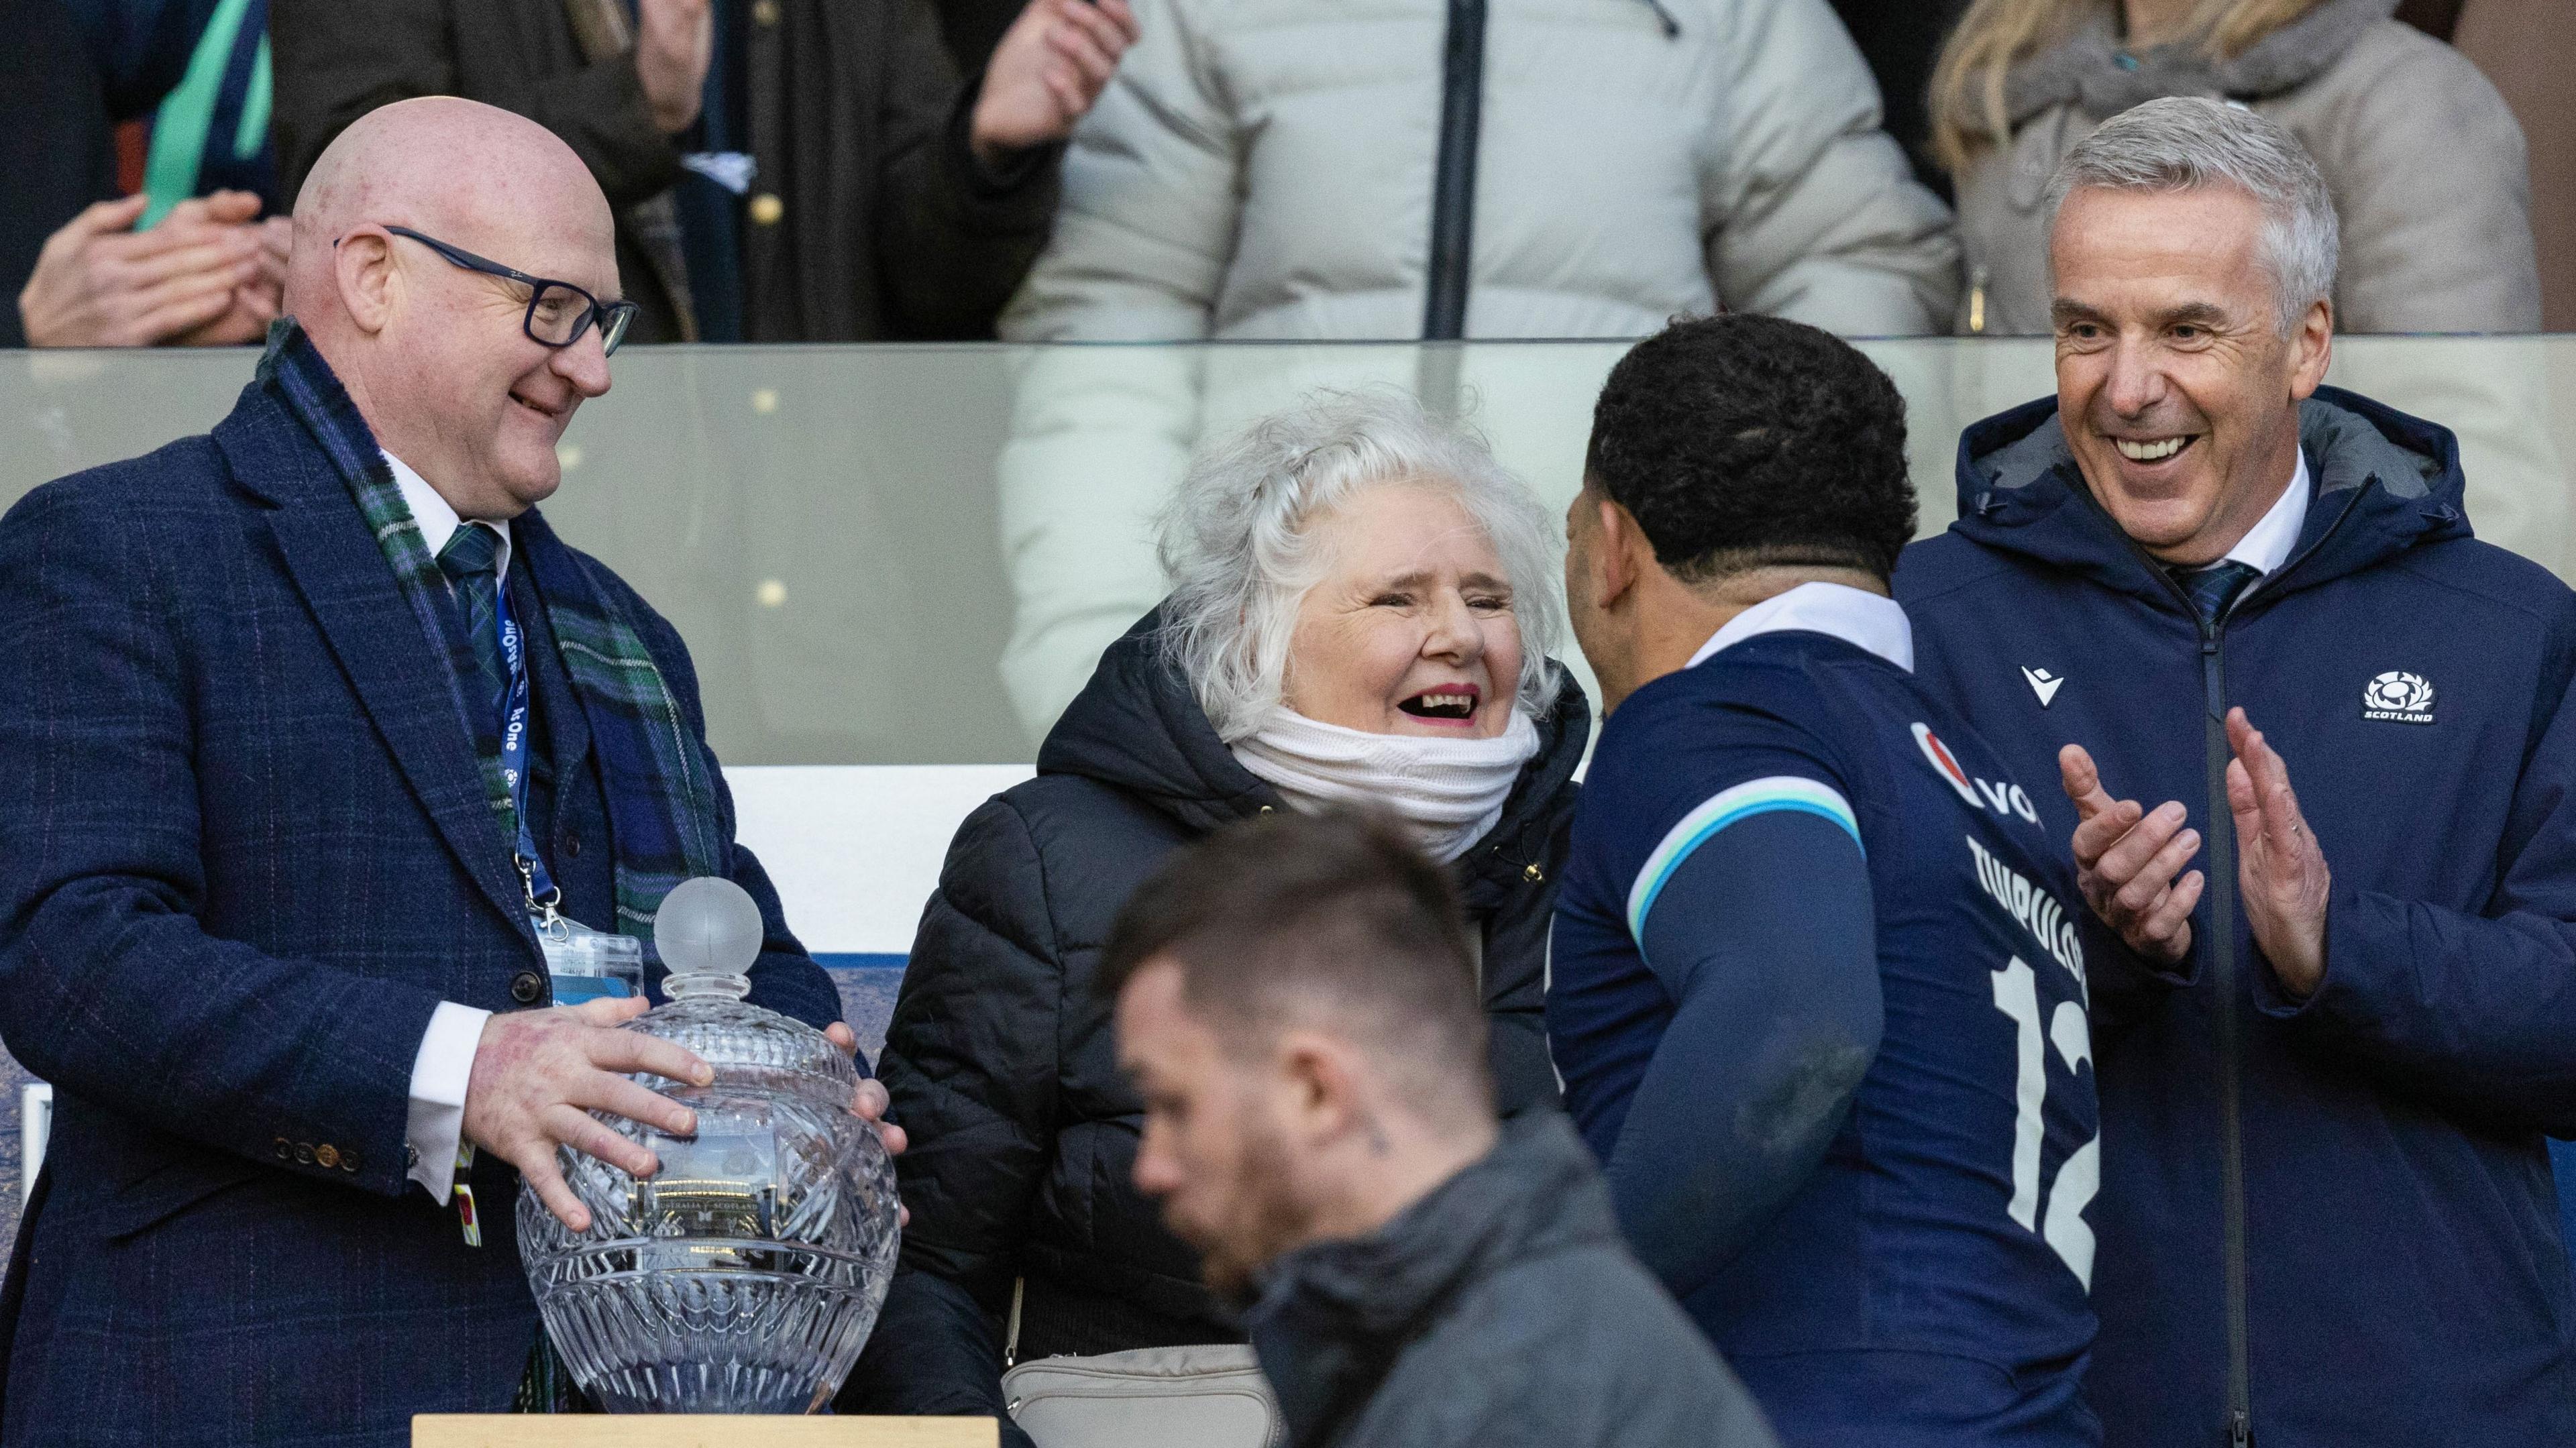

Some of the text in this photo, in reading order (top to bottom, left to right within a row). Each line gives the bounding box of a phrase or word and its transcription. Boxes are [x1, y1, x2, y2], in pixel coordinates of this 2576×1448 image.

[506, 707, 525, 751] AsOne
[2364, 711, 2433, 722] SCOTLAND
[1975, 777, 2041, 825] vo
[1966, 834, 2088, 1011] TUIPULO
[1991, 955, 2100, 1297] 12
